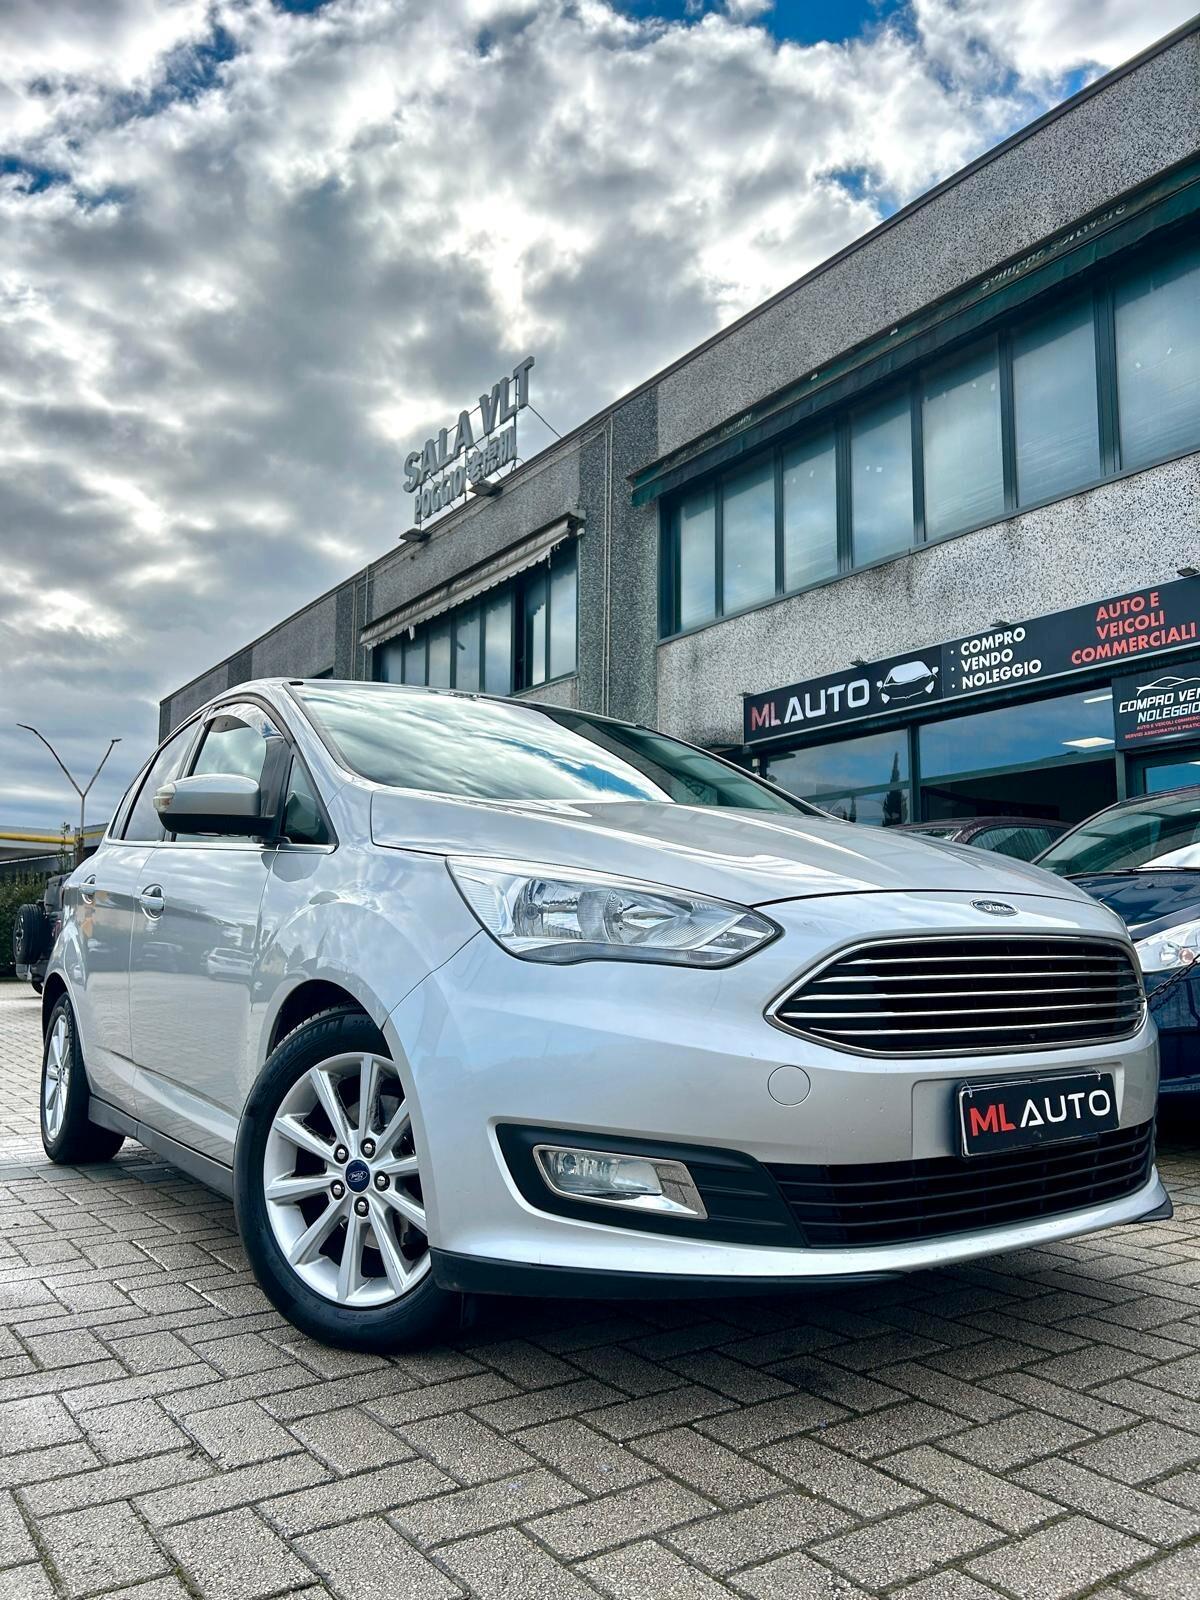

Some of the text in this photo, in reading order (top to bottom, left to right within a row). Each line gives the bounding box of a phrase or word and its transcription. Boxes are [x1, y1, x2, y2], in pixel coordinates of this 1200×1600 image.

[403, 356, 535, 493] SALA VLT
[414, 466, 466, 524] POGGIO
[1096, 592, 1159, 622] AUTO E
[1096, 610, 1165, 640] VEICOLI
[961, 627, 1026, 655] COMPRO
[1071, 622, 1197, 664] COMMERCIALI
[961, 648, 1013, 672] VENDO
[962, 659, 1042, 689] NOLEGGIO
[751, 679, 870, 731] ML AUTO
[1119, 693, 1174, 713] COMPRO
[1138, 701, 1200, 723] NOLEGGIO
[970, 1089, 1110, 1136] ML AUTO
